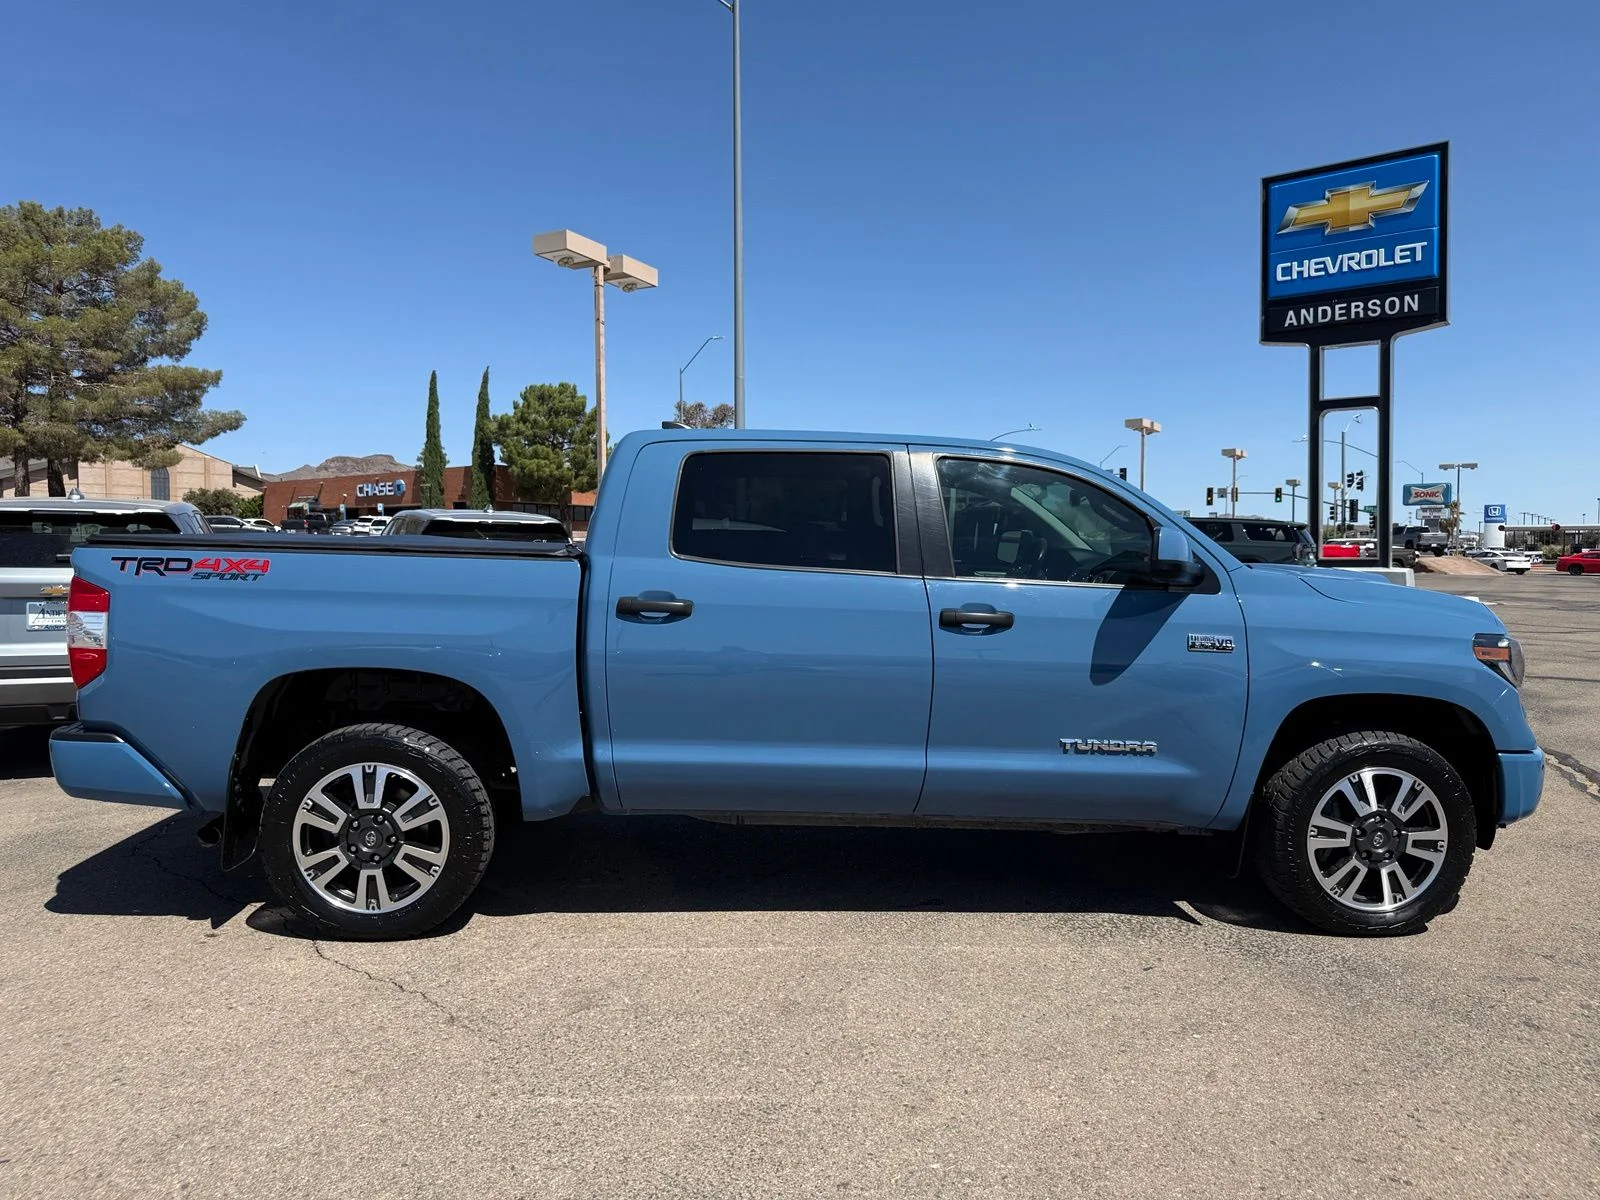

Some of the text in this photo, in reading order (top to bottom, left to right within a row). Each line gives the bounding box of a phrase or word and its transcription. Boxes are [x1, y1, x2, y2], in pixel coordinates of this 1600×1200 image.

[1275, 241, 1428, 282] CHEVROLET
[1284, 293, 1419, 327] ANDERSON
[356, 482, 395, 497] CHASE
[1414, 490, 1441, 499] SONIC
[111, 556, 271, 577] TRD 4X4
[191, 571, 265, 582] SPORT
[1060, 738, 1158, 757] TUNDRA
